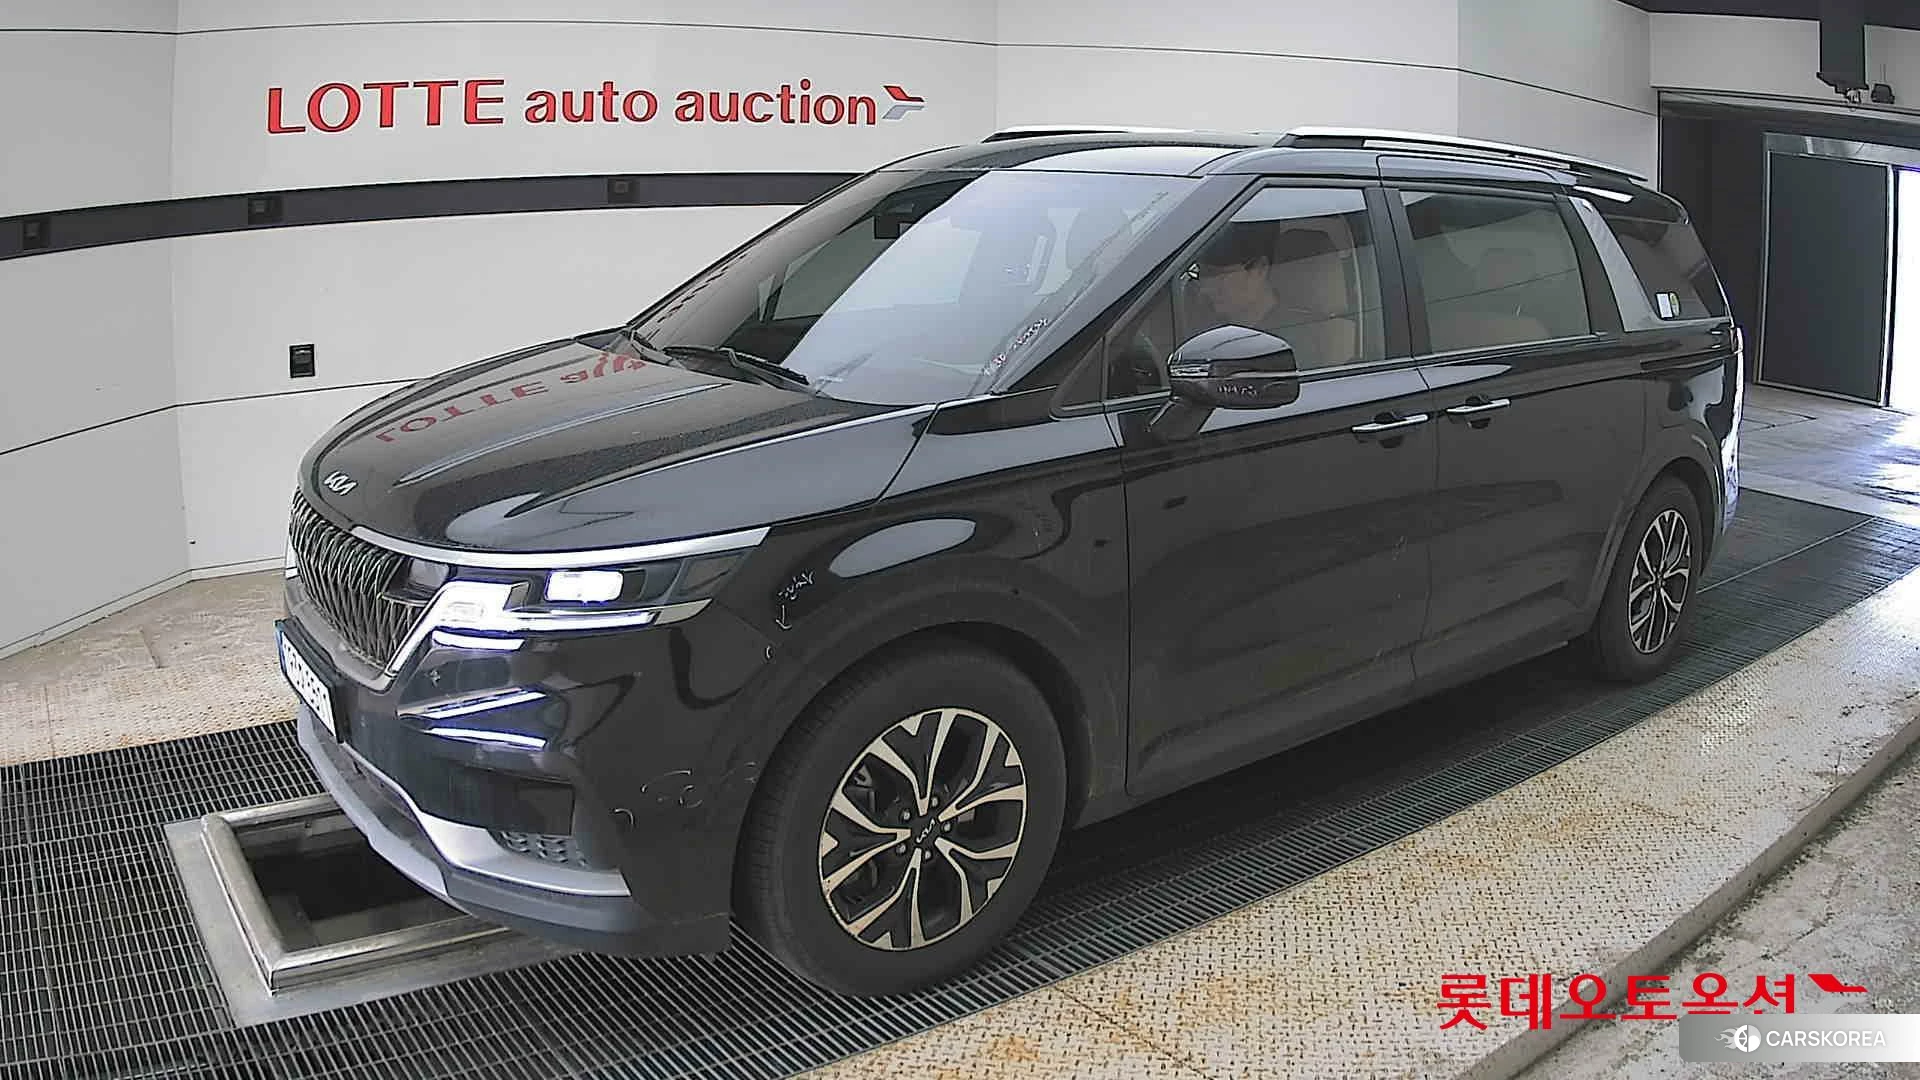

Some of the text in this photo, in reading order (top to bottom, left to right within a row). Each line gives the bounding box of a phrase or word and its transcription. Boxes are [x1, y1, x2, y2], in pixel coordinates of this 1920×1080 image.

[267, 78, 877, 134] LOTTE auto auction
